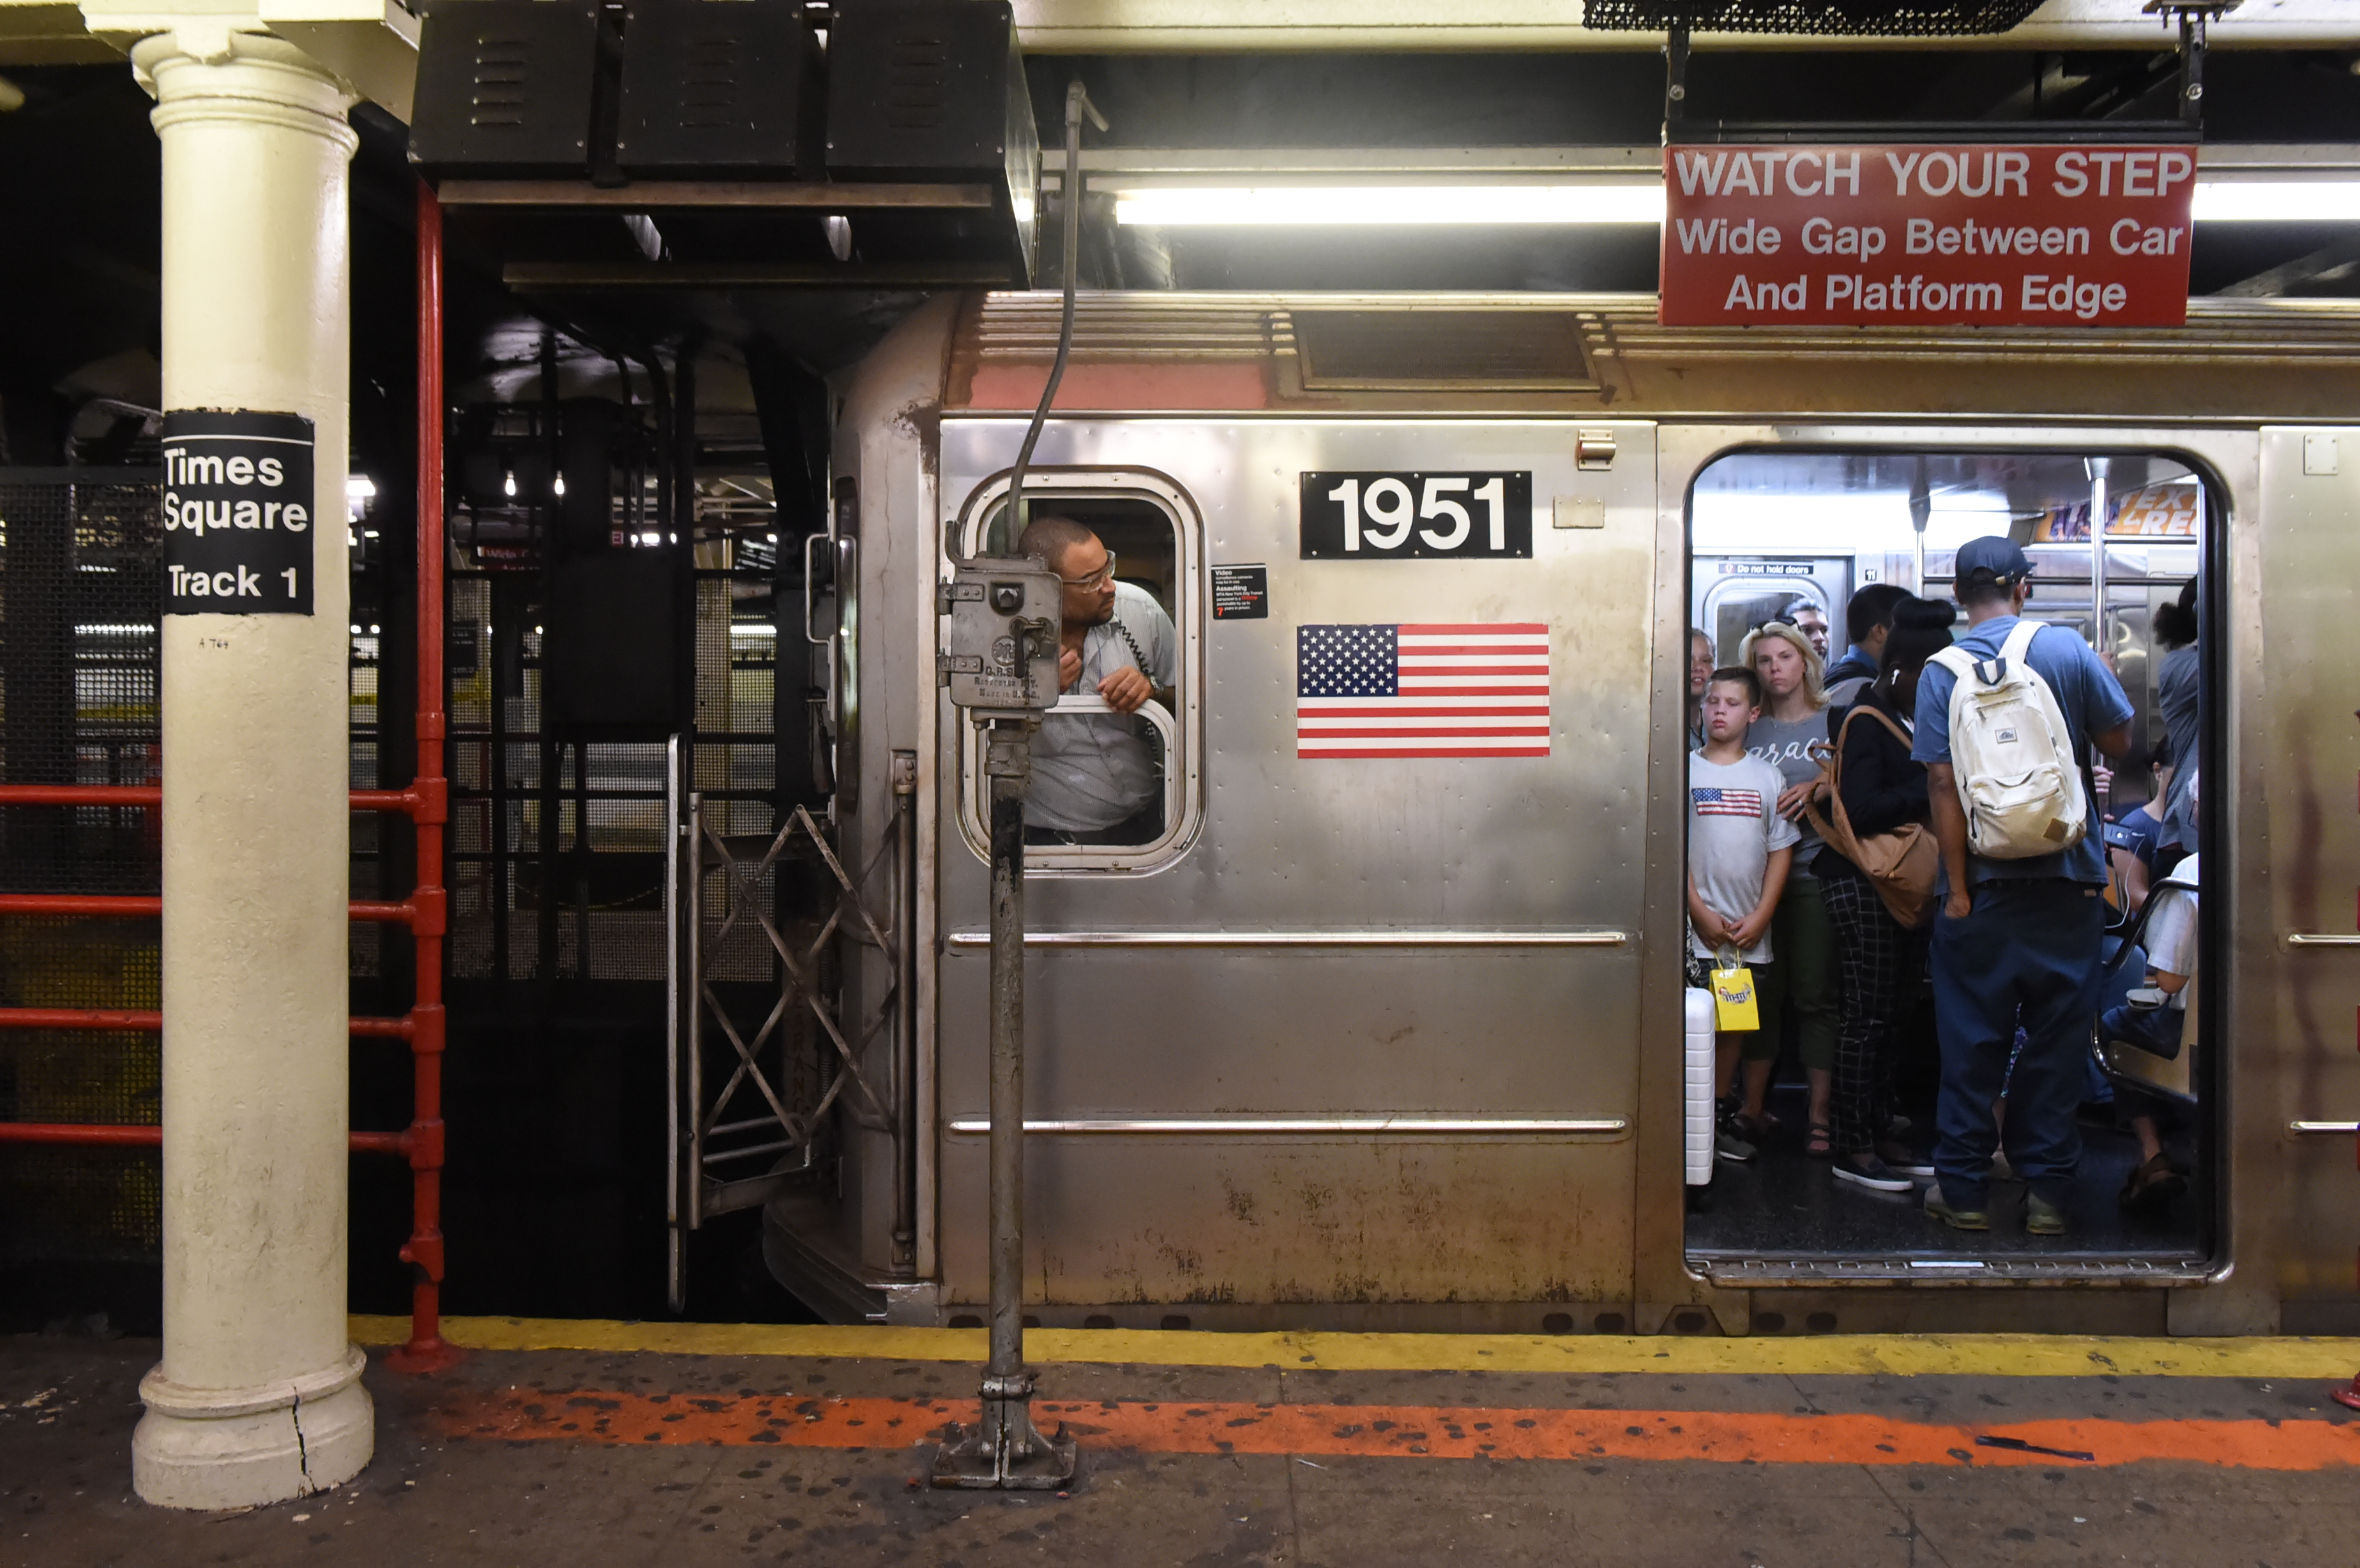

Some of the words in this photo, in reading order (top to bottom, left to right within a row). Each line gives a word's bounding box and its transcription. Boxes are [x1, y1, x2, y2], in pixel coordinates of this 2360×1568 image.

[1674, 152, 1861, 197] WATCH
[1886, 152, 2029, 197] YOUR
[2054, 153, 2192, 197] STEP
[1676, 218, 1781, 253] Wide
[1802, 217, 1886, 262] Gap
[1907, 219, 2089, 254] Between
[2110, 219, 2184, 255] Car
[1724, 275, 1806, 310] And
[1826, 275, 2002, 311] Platform
[2022, 276, 2127, 318] Edge
[164, 448, 284, 487] Times
[164, 492, 308, 537] Square
[1329, 478, 1505, 551] 1951
[168, 565, 262, 597] Track
[281, 567, 296, 598] 1
[1737, 565, 1749, 573] Do
[1785, 566, 1809, 574] doors
[1216, 607, 1224, 617] 7
